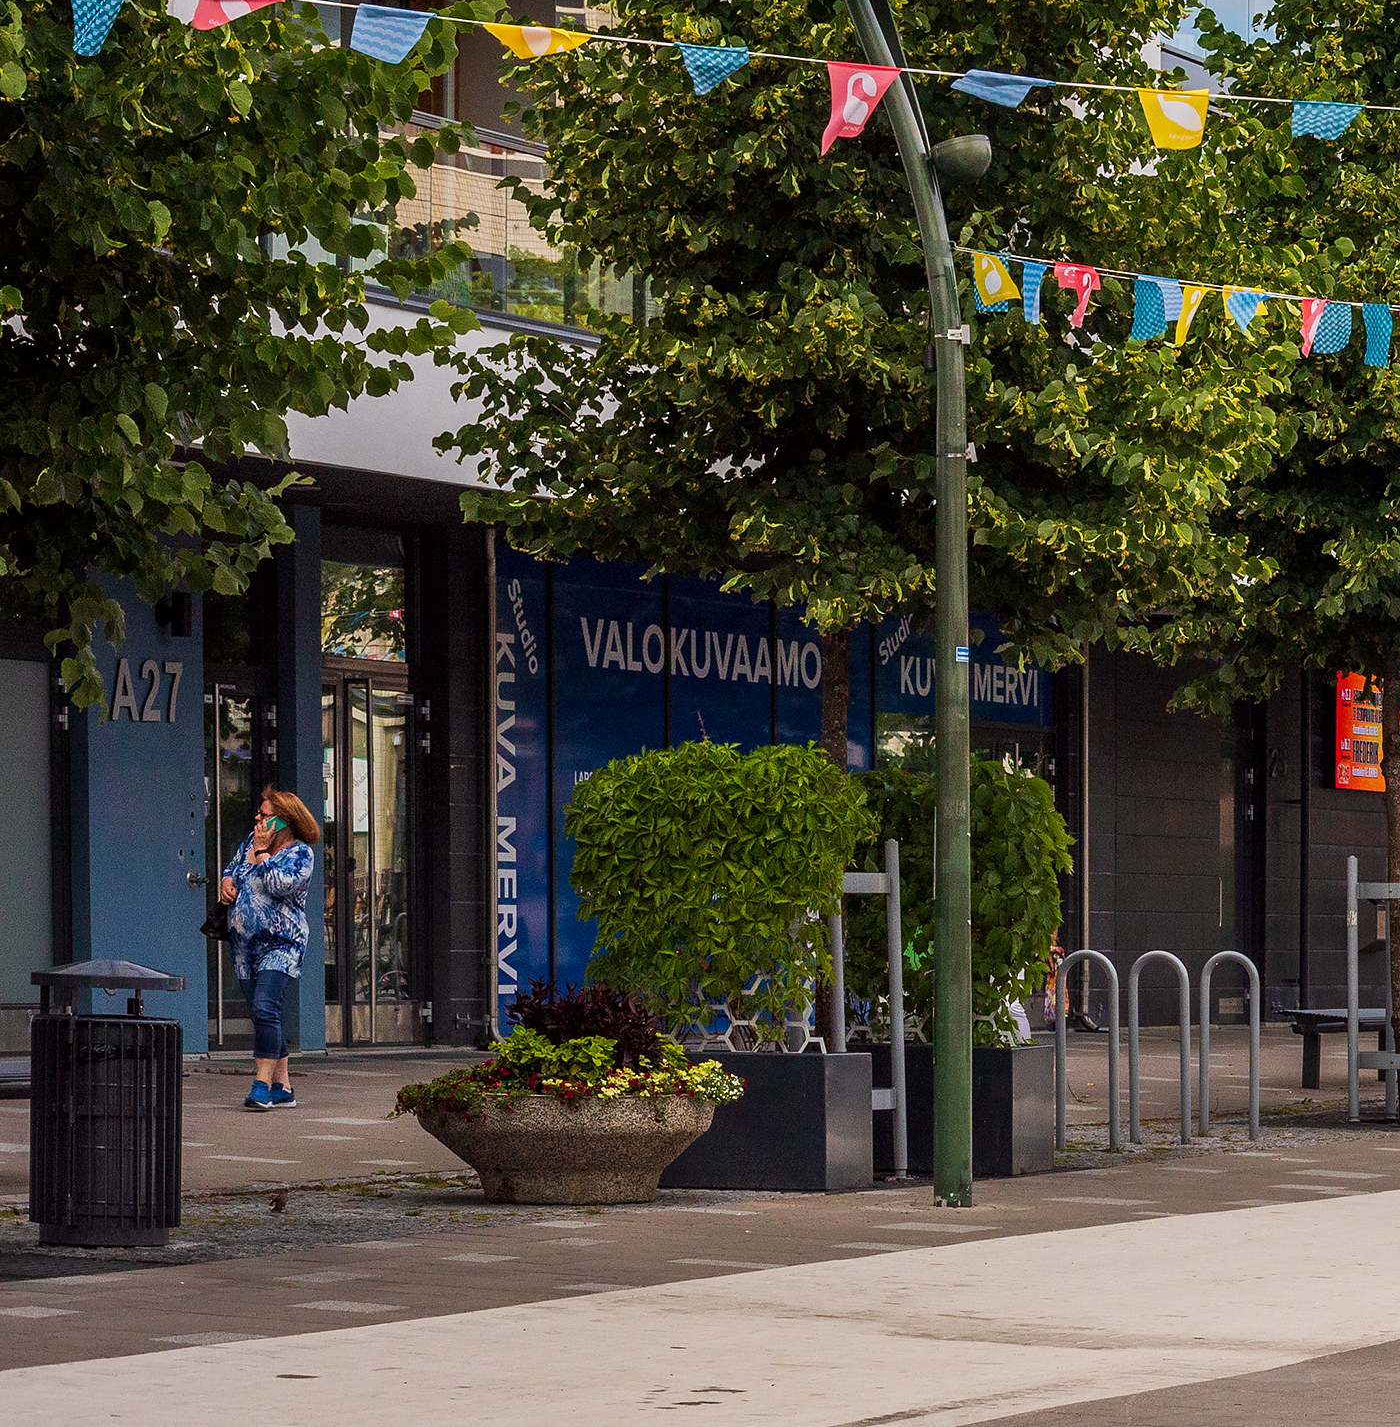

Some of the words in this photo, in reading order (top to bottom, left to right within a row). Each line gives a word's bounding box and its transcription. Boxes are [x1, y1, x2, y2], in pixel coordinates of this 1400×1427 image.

[507, 578, 539, 675] Studio
[580, 616, 822, 689] VALOKUVAAMO
[878, 613, 913, 666] Studi
[111, 657, 183, 723] A27
[496, 632, 517, 793] KUVA
[901, 655, 936, 697] KU
[973, 662, 1039, 707] MERVI
[497, 816, 518, 995] MERVI
